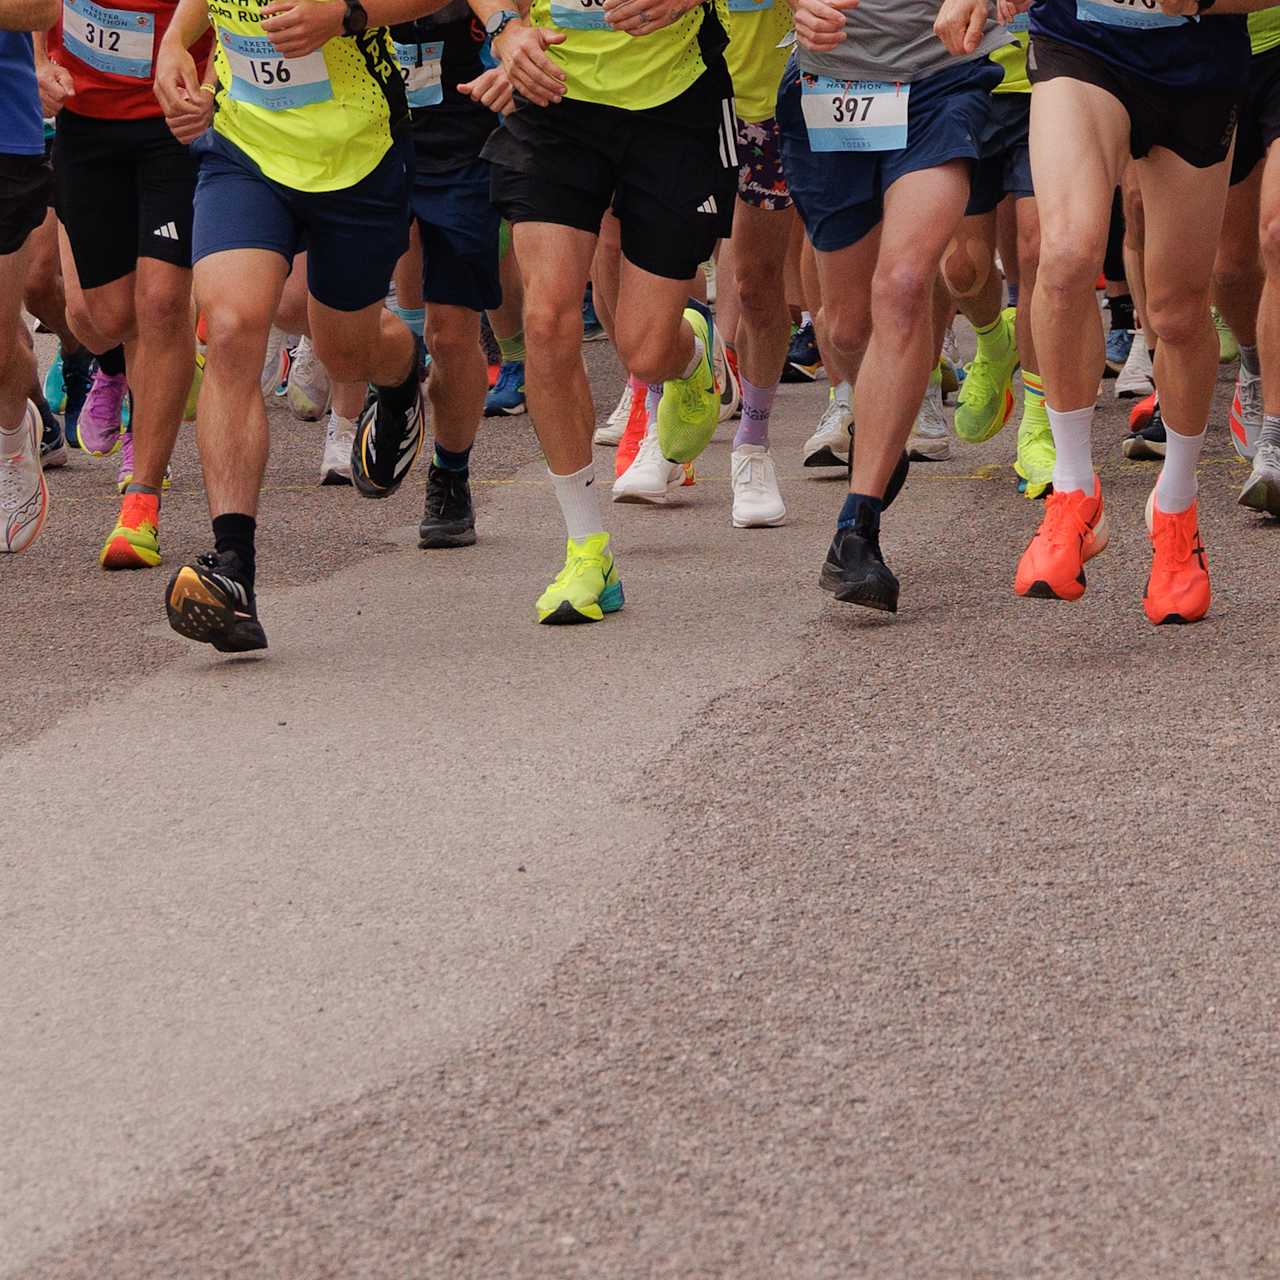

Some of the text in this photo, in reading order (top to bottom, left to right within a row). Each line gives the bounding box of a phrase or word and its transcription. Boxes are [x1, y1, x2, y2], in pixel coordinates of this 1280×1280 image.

[85, 22, 120, 52] 312
[239, 45, 276, 54] MARATH
[250, 60, 291, 84] 156
[826, 82, 882, 90] MARATHON
[832, 96, 875, 122] 397
